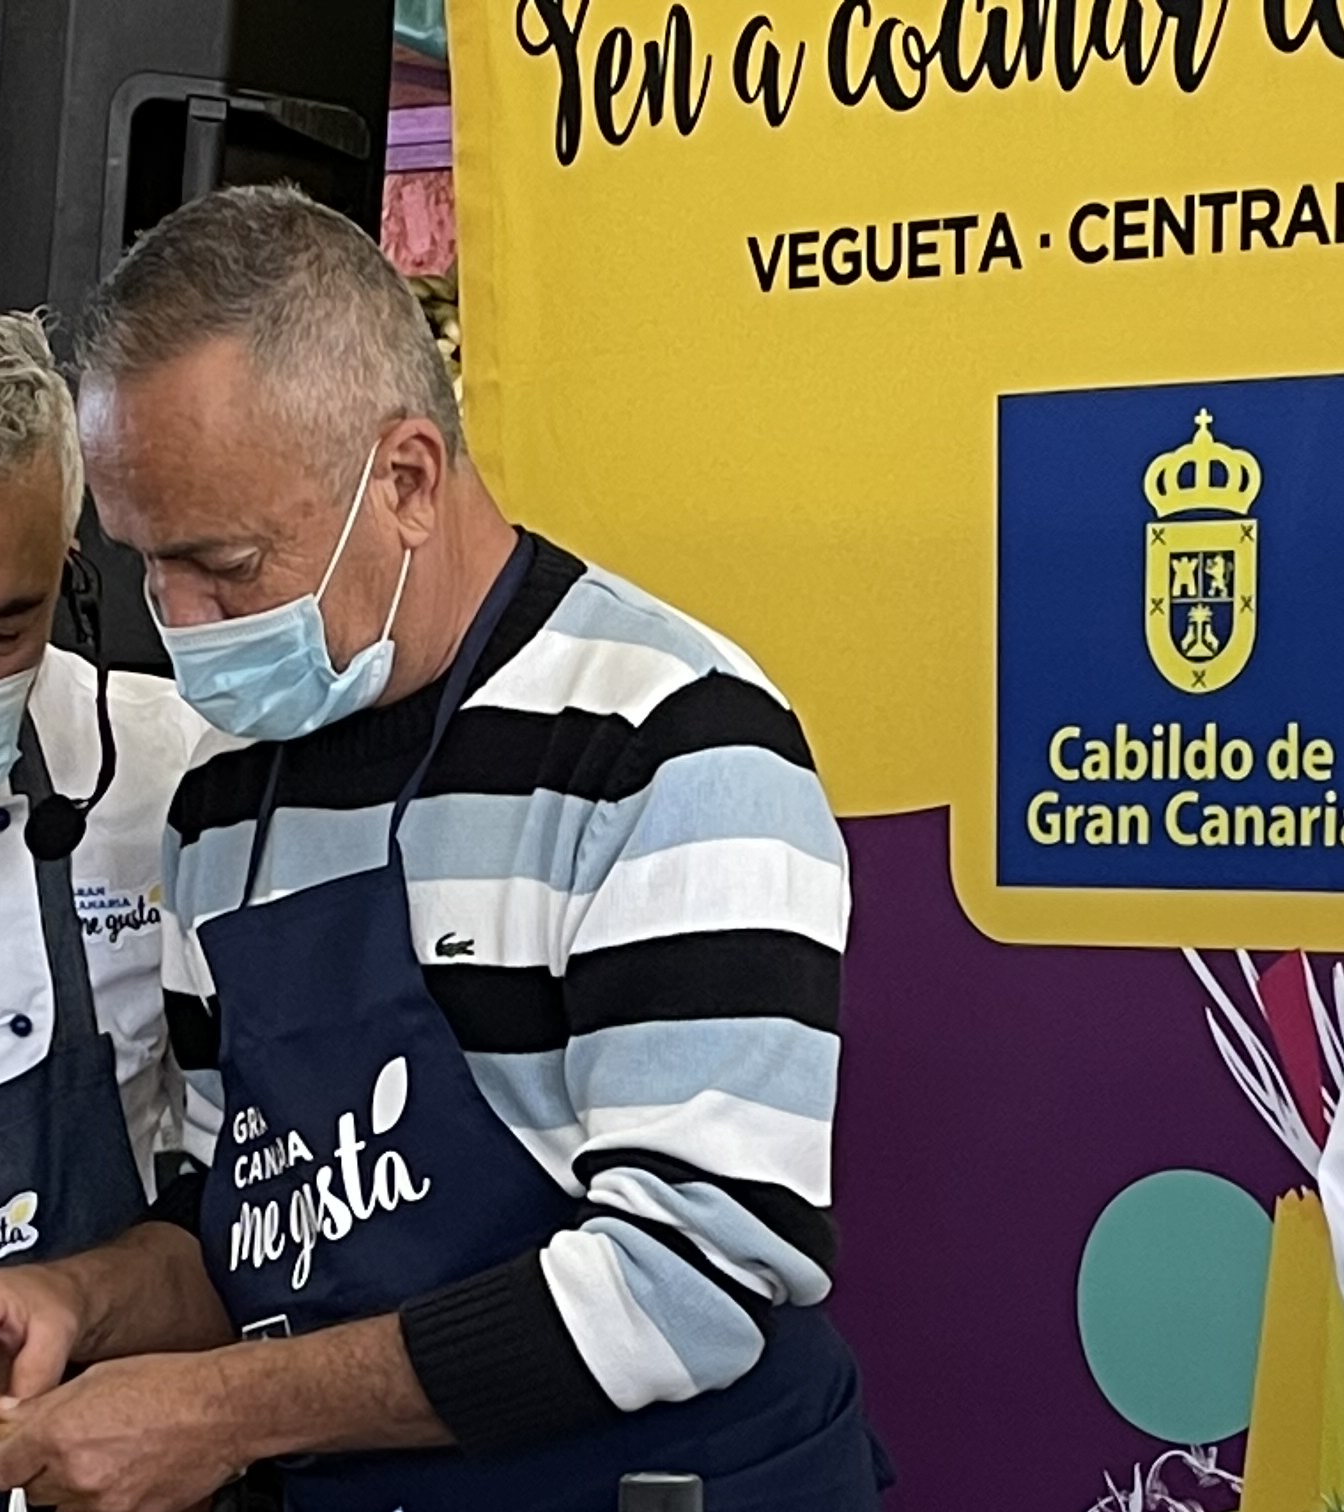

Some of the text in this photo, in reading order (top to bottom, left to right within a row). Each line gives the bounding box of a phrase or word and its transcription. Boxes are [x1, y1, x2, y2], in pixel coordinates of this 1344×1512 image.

[733, 17, 805, 127] a
[747, 211, 1023, 292] VEGUETA
[1049, 723, 1335, 781] Cabildo de
[1027, 792, 1150, 846] Gran
[74, 886, 105, 897] RAN
[76, 897, 132, 910] ANARIA
[105, 894, 162, 943] gusta
[229, 1201, 286, 1272] me
